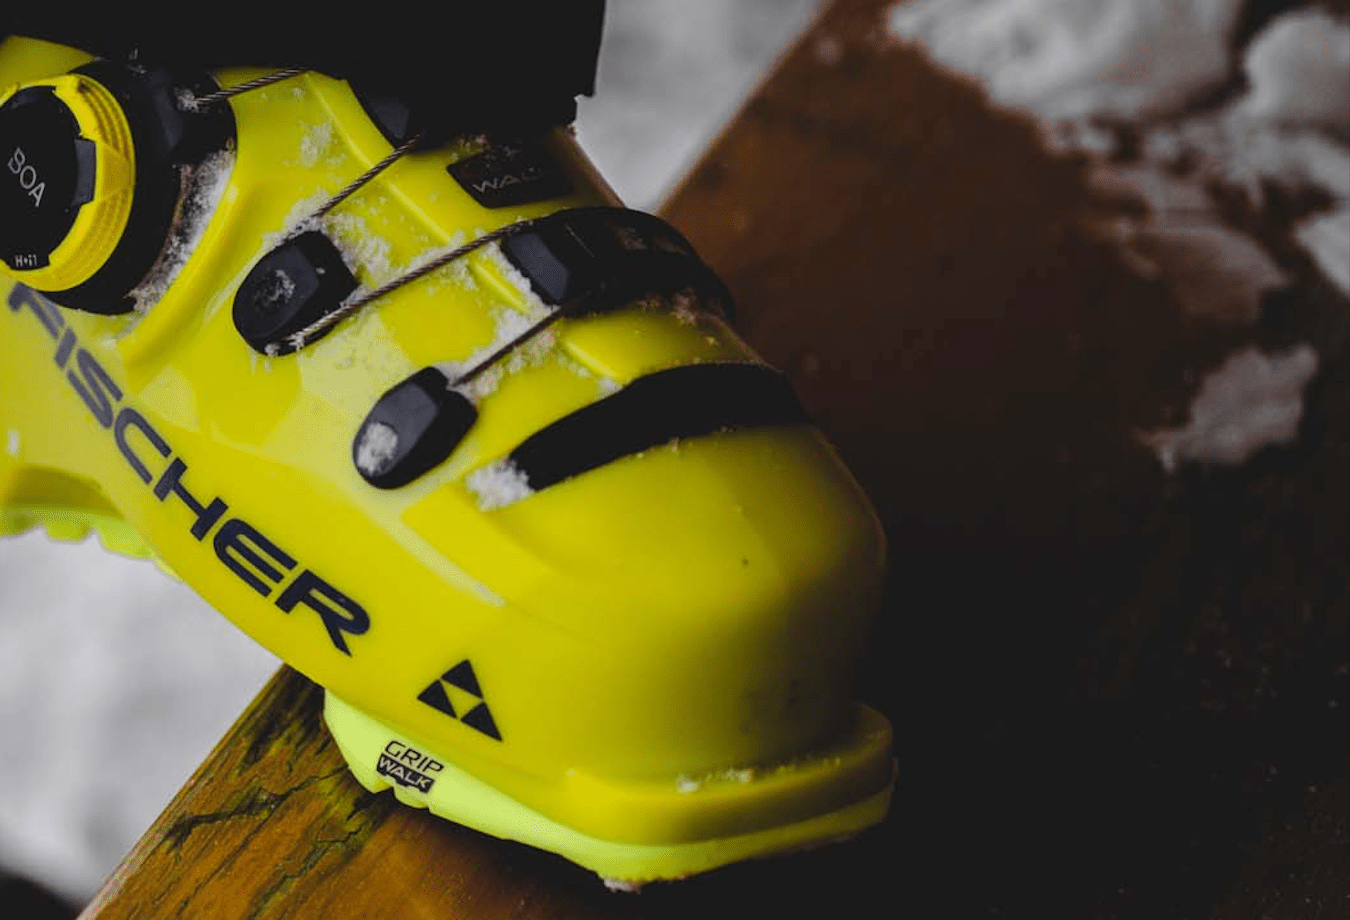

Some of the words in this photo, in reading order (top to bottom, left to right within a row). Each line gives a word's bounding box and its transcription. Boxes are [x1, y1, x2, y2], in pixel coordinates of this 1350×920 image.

[7, 147, 46, 207] BOA
[8, 281, 371, 658] FISCHER
[379, 757, 432, 788] WALK
[385, 740, 444, 773] GRIP
